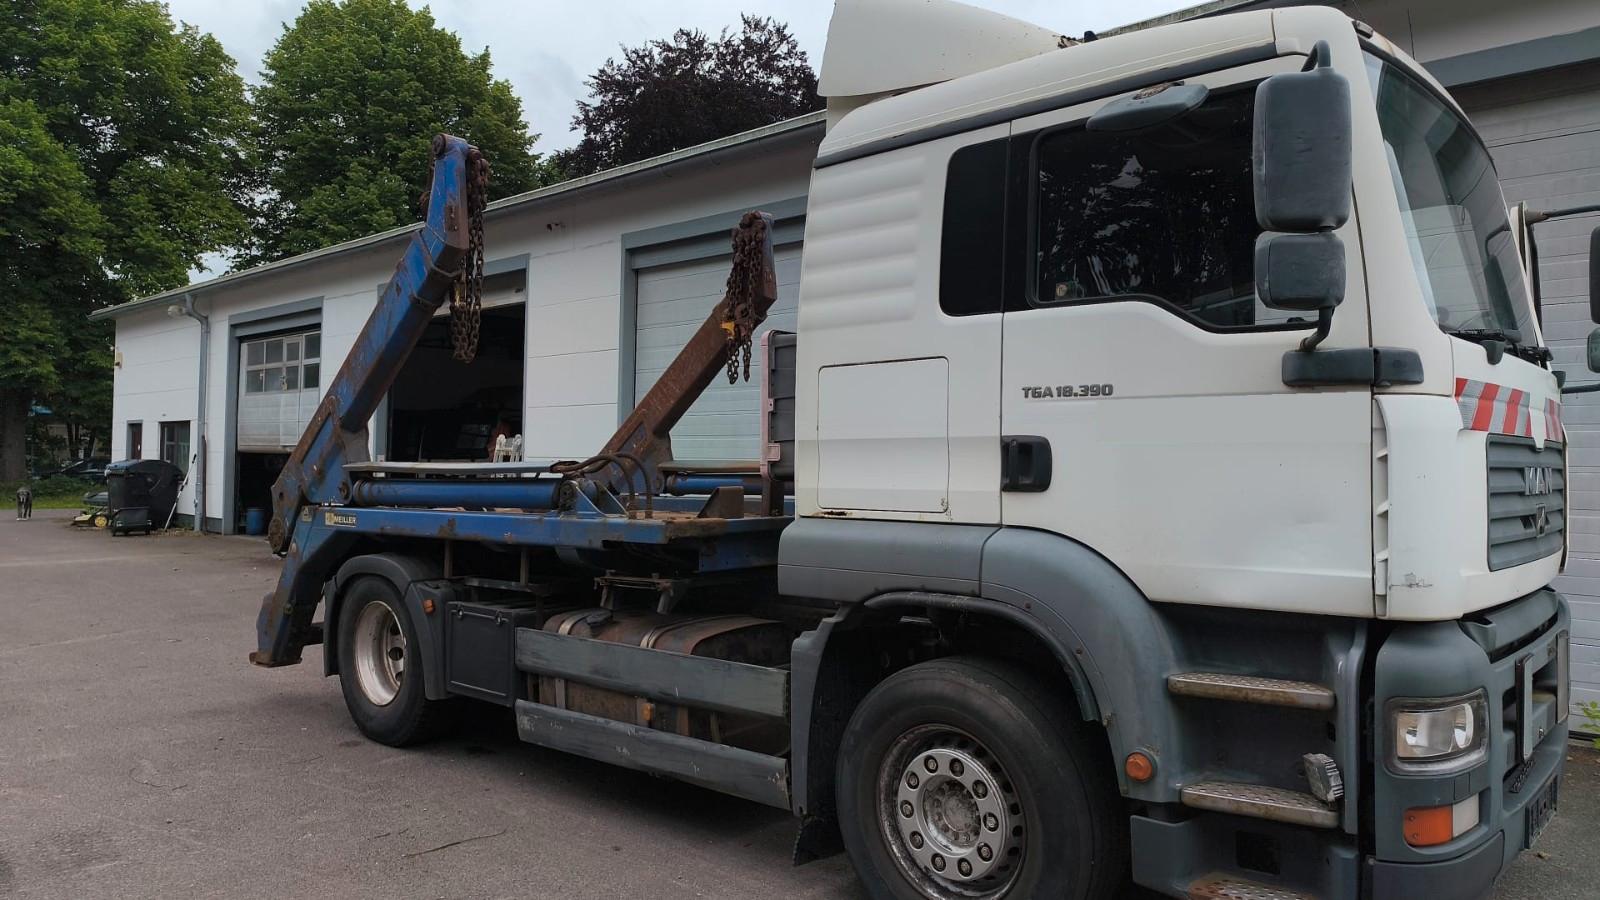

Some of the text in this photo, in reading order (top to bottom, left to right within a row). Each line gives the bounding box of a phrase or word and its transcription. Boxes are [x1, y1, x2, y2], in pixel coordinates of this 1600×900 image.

[1022, 384, 1114, 398] TGA 18.390
[1524, 466, 1553, 495] MAN
